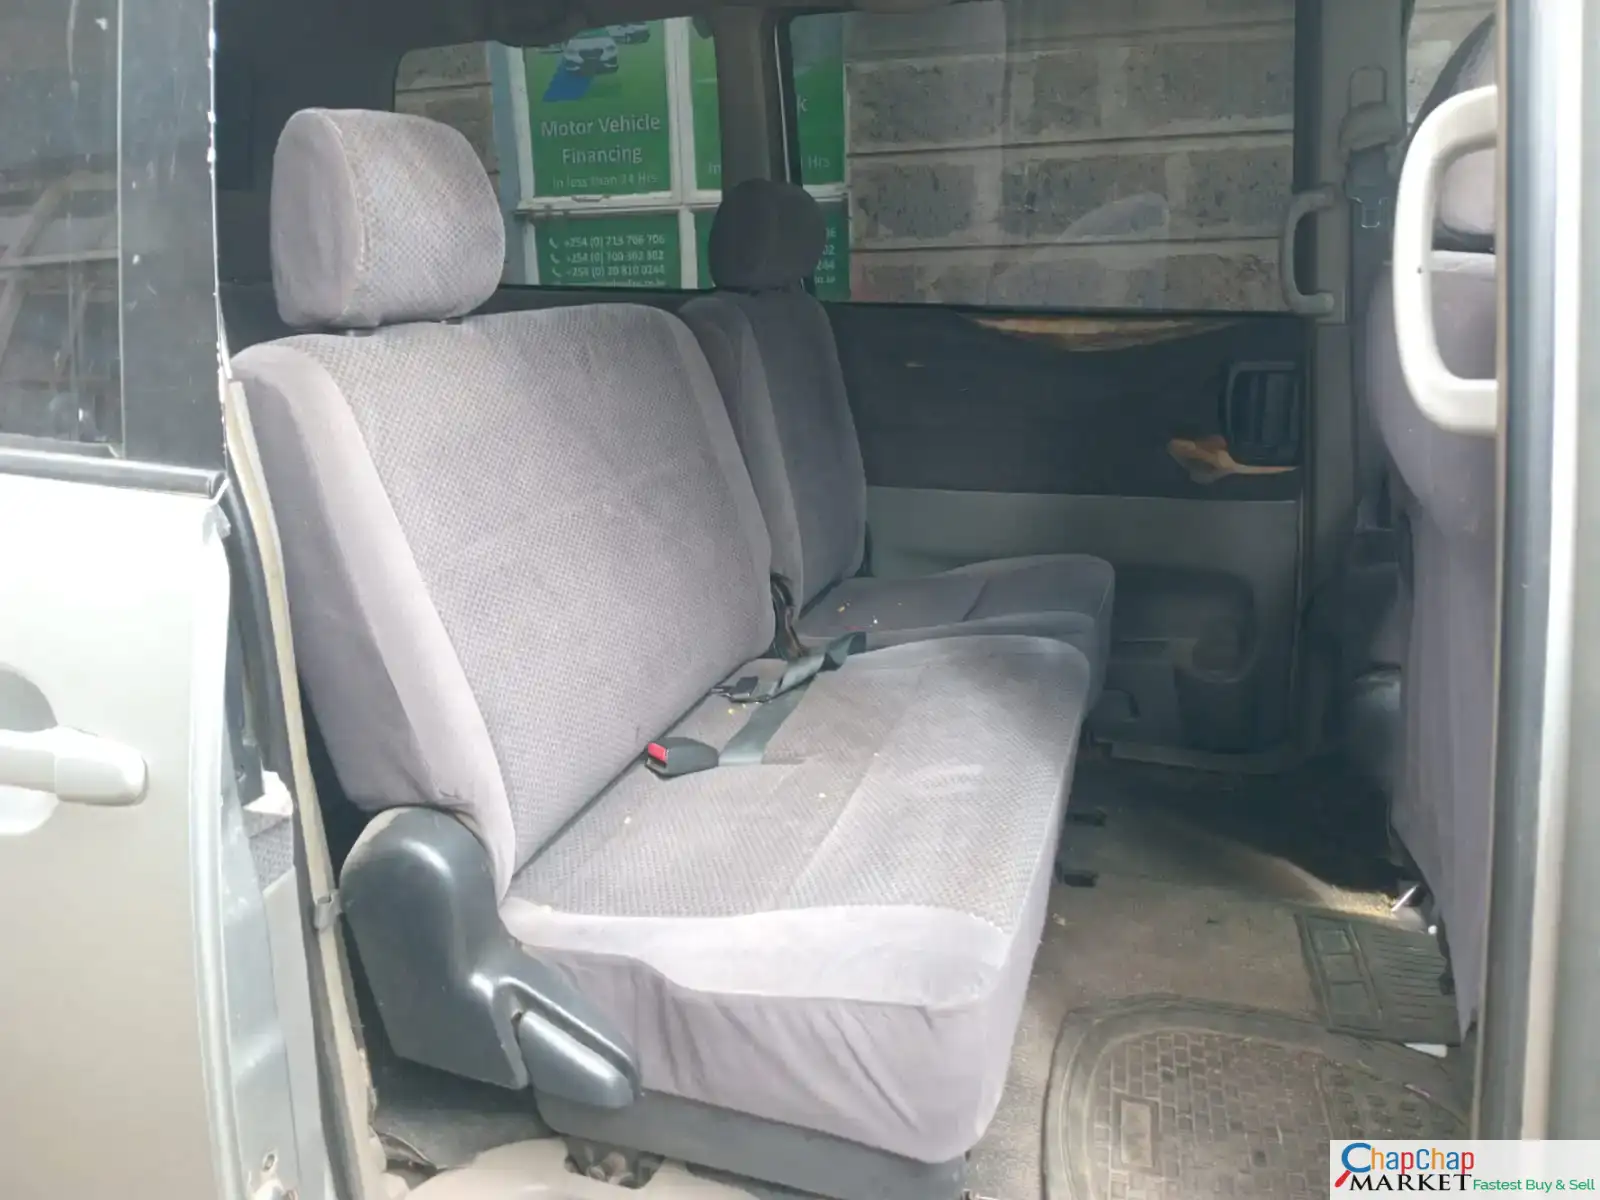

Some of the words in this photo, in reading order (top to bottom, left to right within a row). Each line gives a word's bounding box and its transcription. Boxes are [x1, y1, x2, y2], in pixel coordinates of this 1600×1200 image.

[541, 120, 593, 137] Motor
[598, 114, 661, 133] Vehicle
[562, 144, 643, 164] Financing
